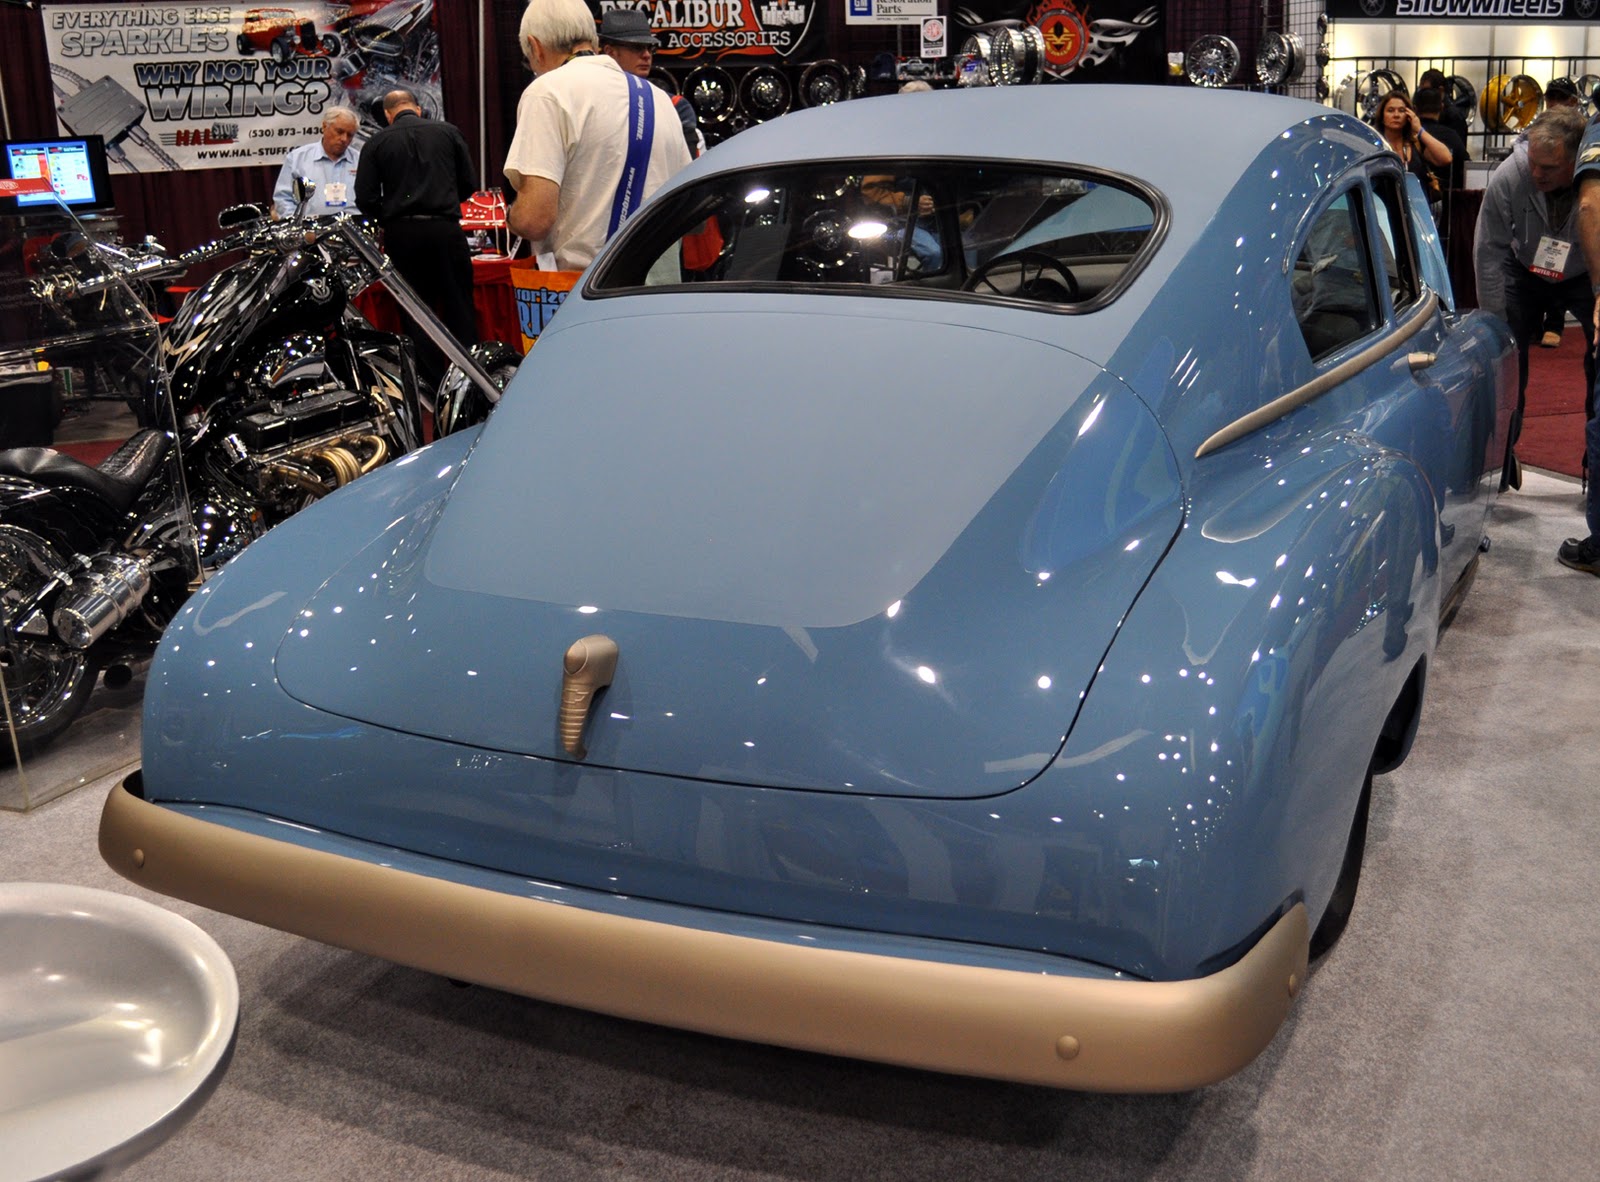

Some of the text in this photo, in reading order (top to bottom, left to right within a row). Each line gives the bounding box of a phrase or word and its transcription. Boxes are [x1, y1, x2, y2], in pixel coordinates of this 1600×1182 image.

[52, 7, 231, 30] EVERYTHING ELSE
[876, 4, 902, 14] Parts
[61, 27, 229, 58] SPARKLES
[667, 31, 791, 48] ACCESSORIES
[134, 56, 331, 87] WHY NOT YOUR
[145, 81, 331, 121] WIRING?
[176, 128, 233, 147] HAL
[248, 128, 275, 139] (530)
[197, 146, 301, 159] WWW.HAL-STUFF.
